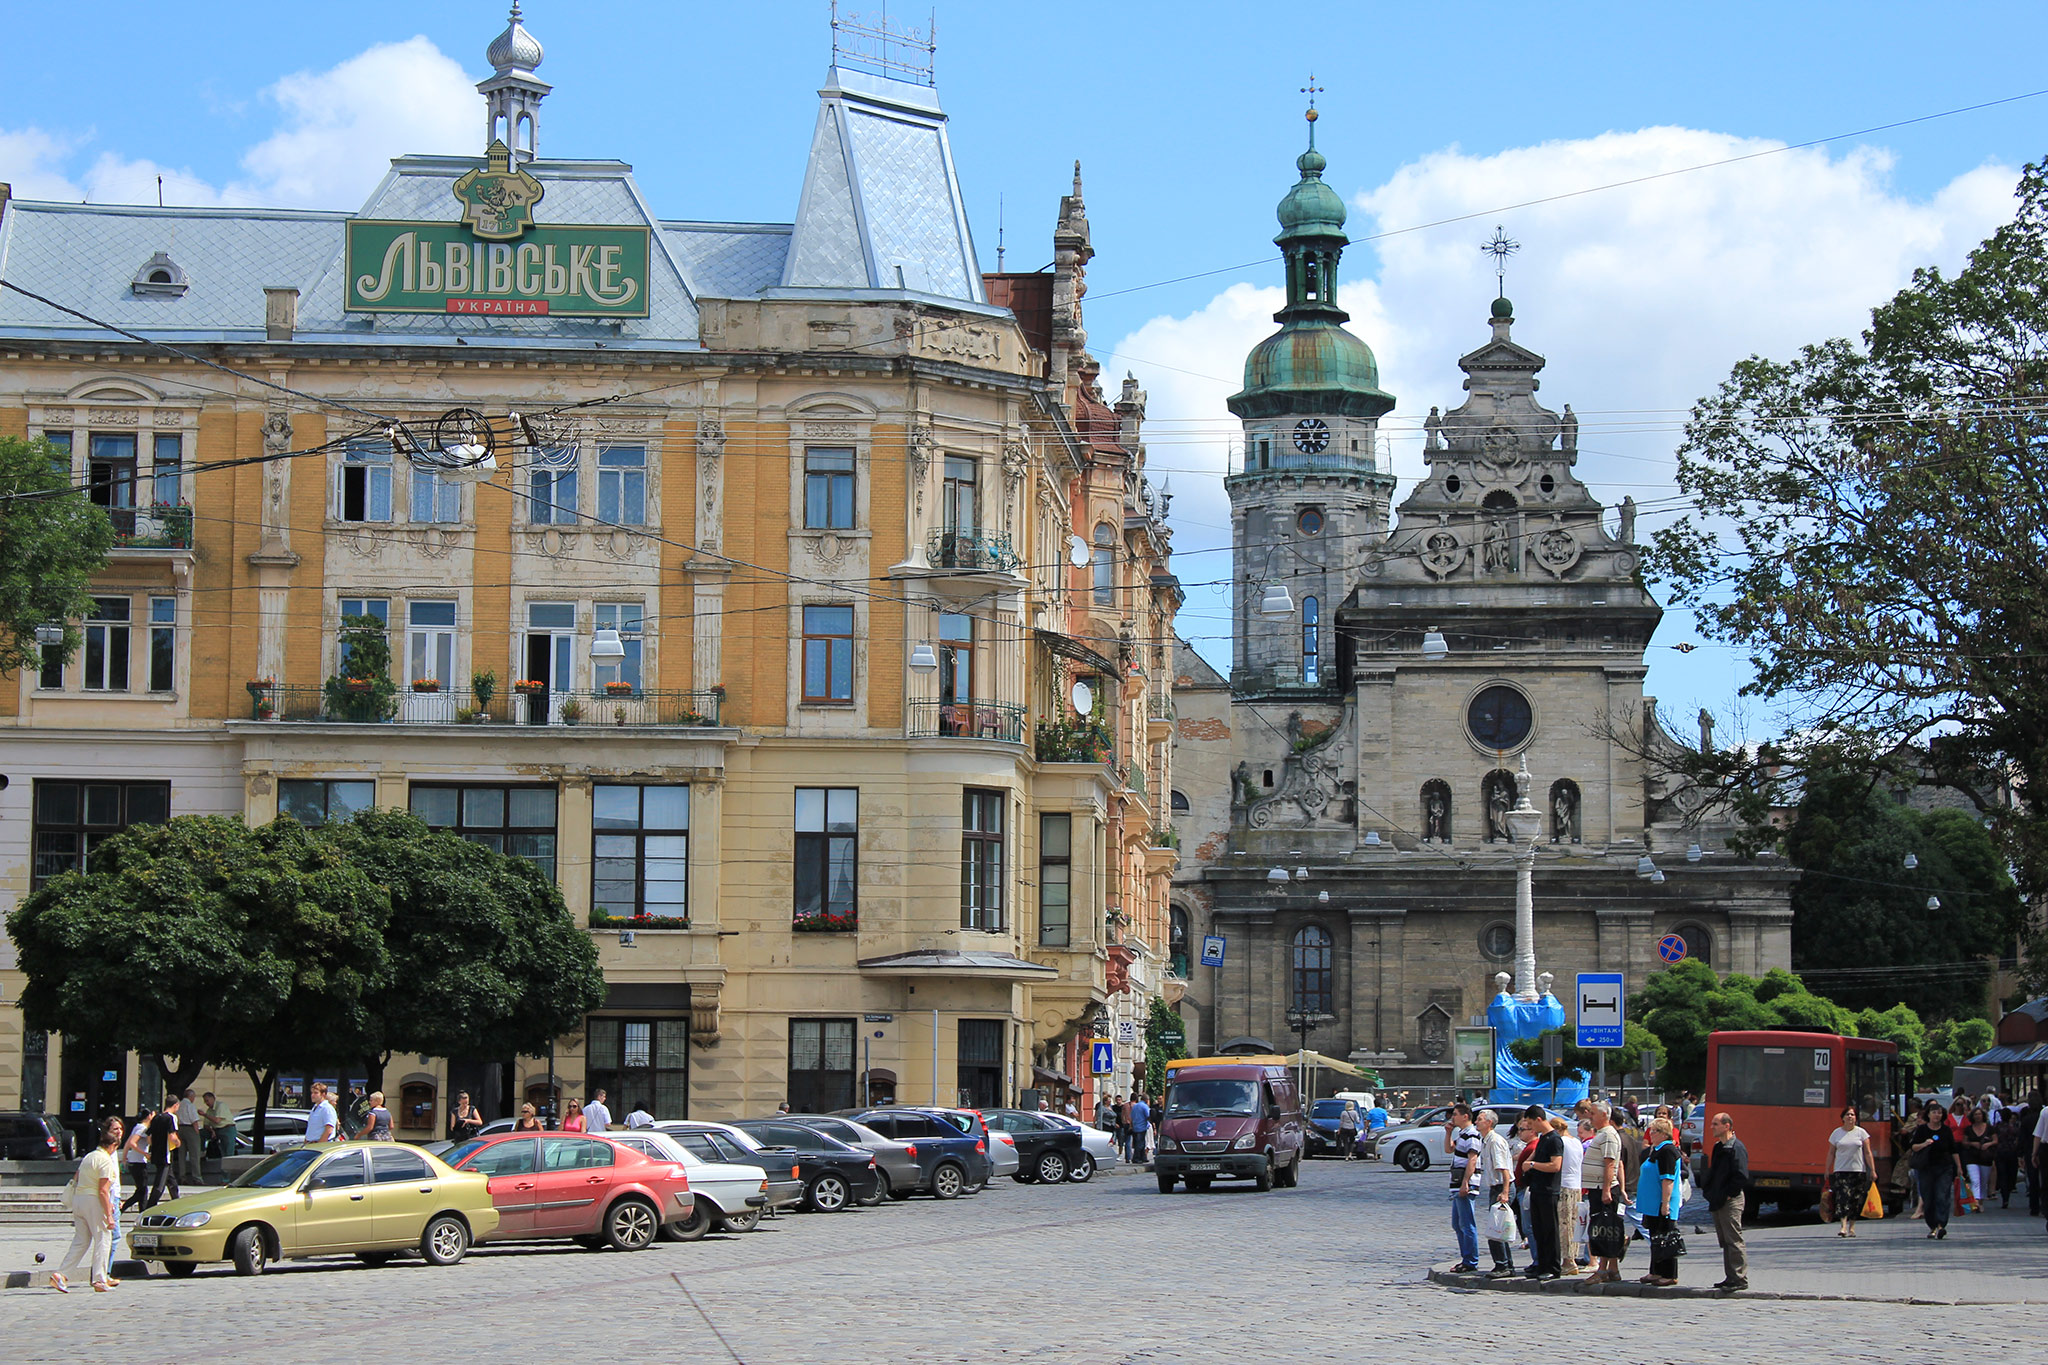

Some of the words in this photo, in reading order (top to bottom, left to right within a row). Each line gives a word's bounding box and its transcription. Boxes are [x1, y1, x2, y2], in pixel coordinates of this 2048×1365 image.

[481, 219, 513, 231] 1715
[457, 299, 538, 314] УКРАЇНА
[1815, 1052, 1828, 1066] 70
[1592, 1225, 1620, 1238] BOSS
